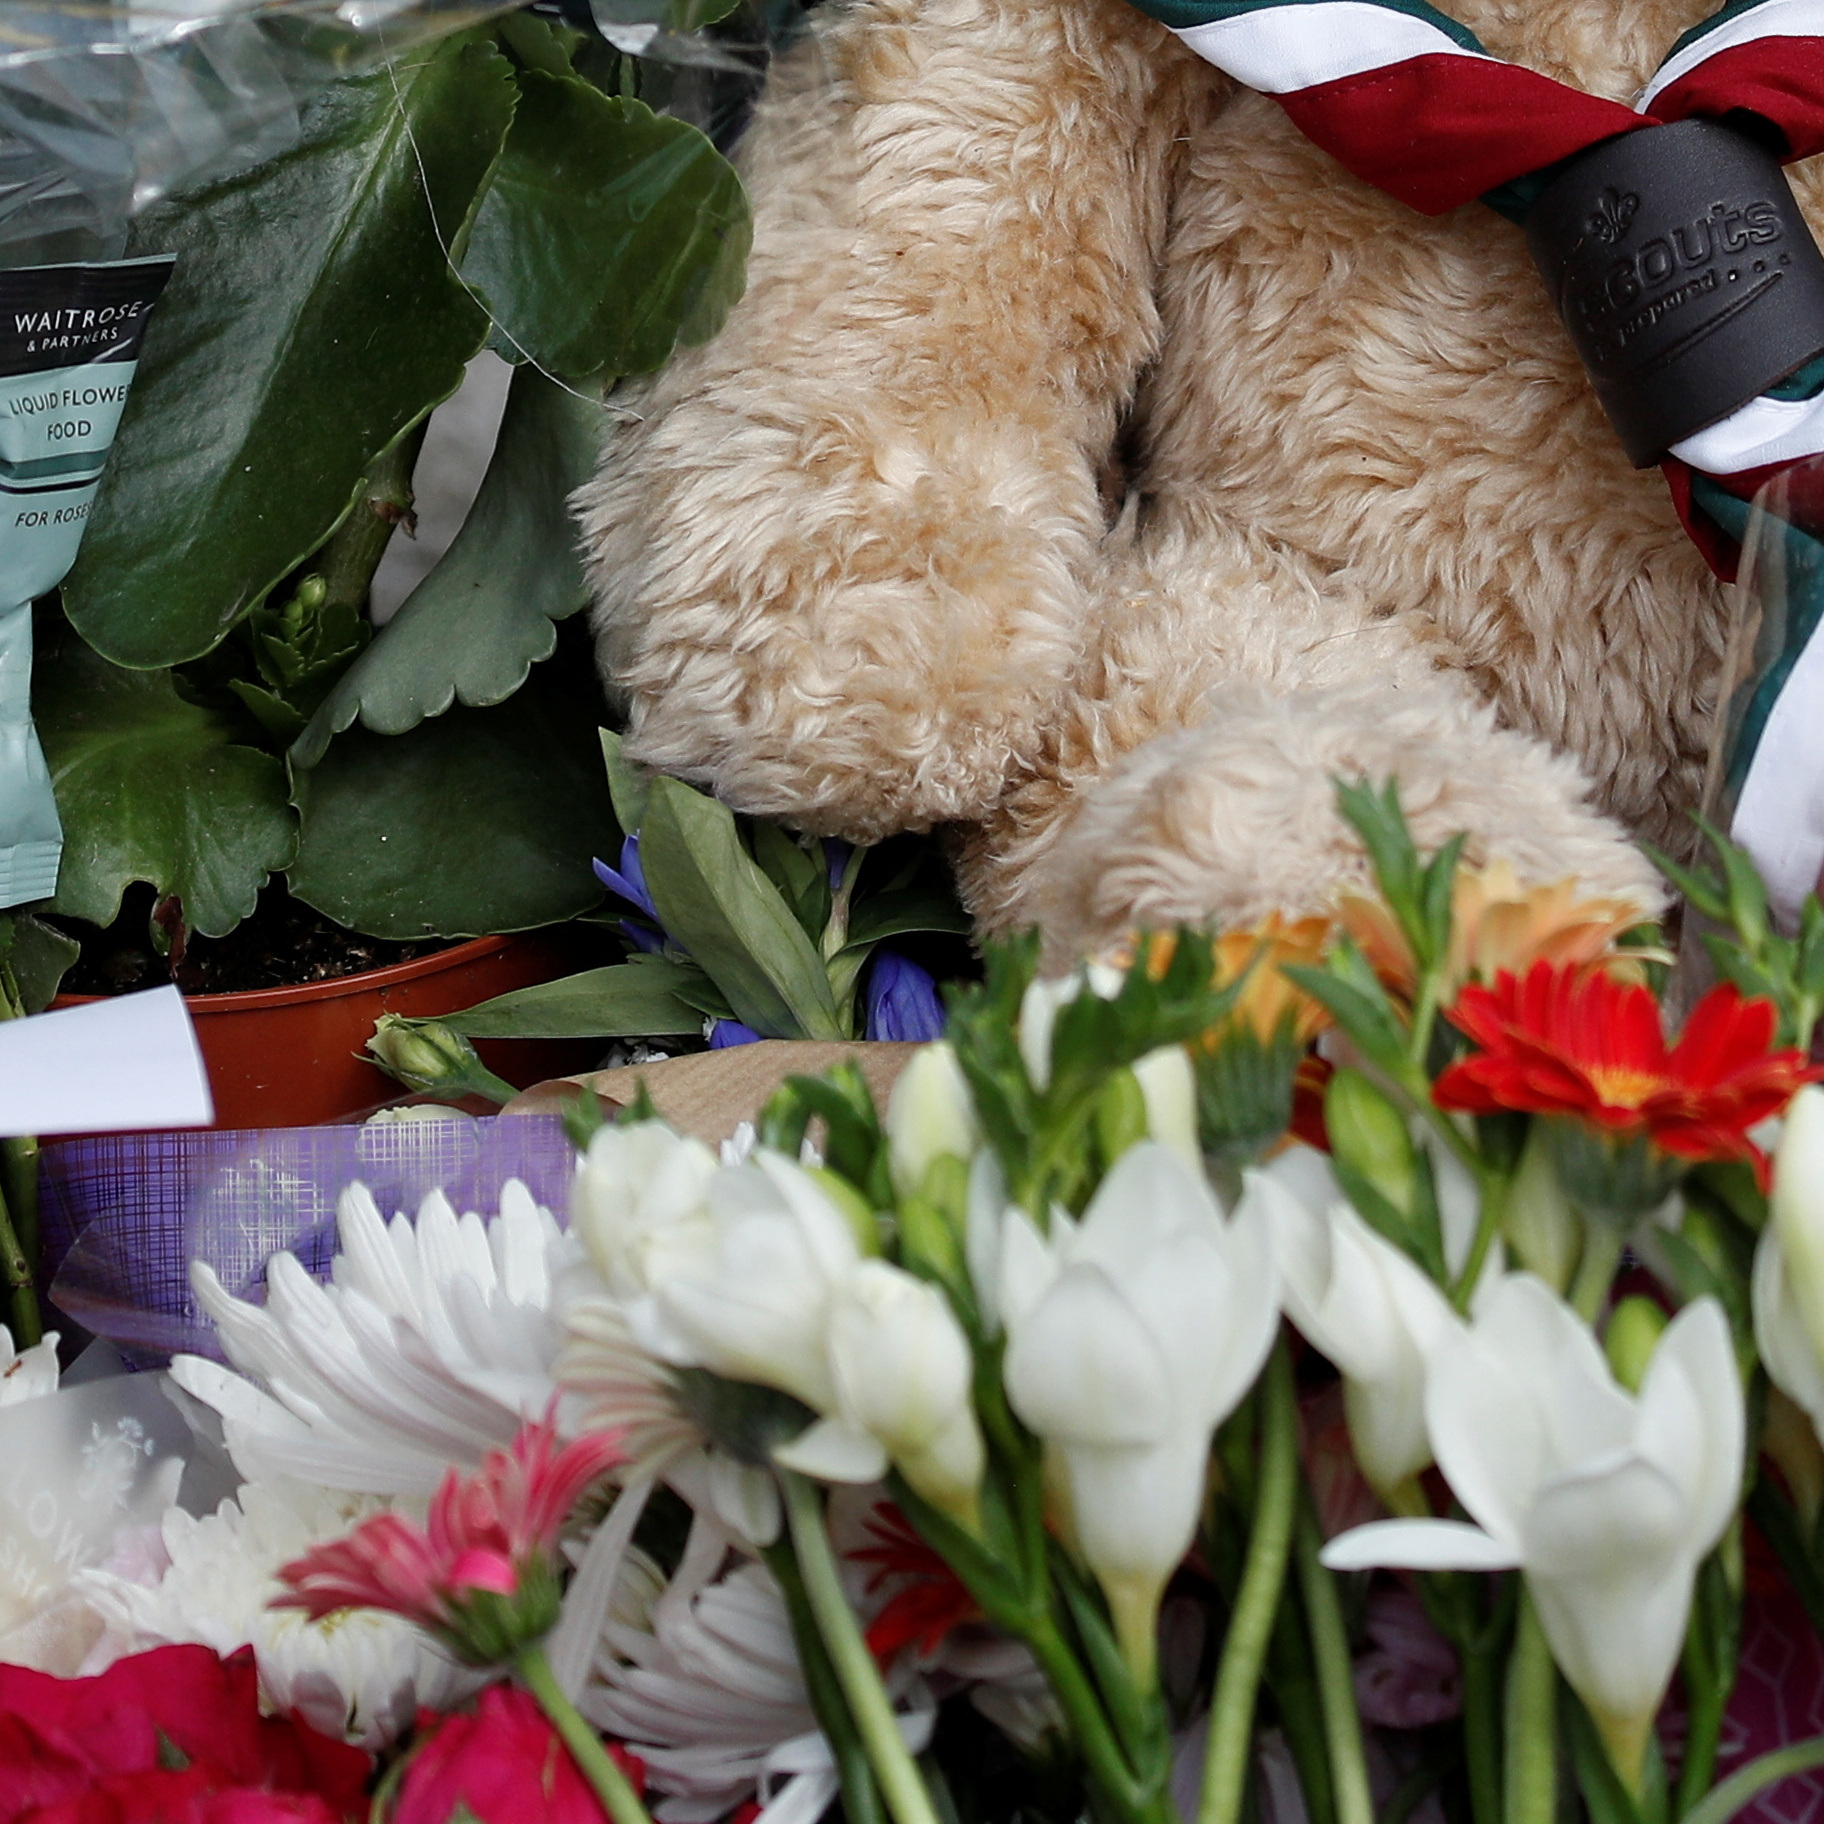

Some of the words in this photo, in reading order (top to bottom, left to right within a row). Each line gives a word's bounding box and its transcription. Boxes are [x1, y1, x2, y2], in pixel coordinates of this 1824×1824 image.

[1582, 197, 1785, 316] couts
[14, 300, 143, 334] WAITROSE
[26, 339, 36, 353] &
[42, 326, 118, 350] PARTNERS
[9, 392, 58, 416] LIQUID
[47, 420, 91, 442] FOOD
[15, 510, 49, 528] FOR
